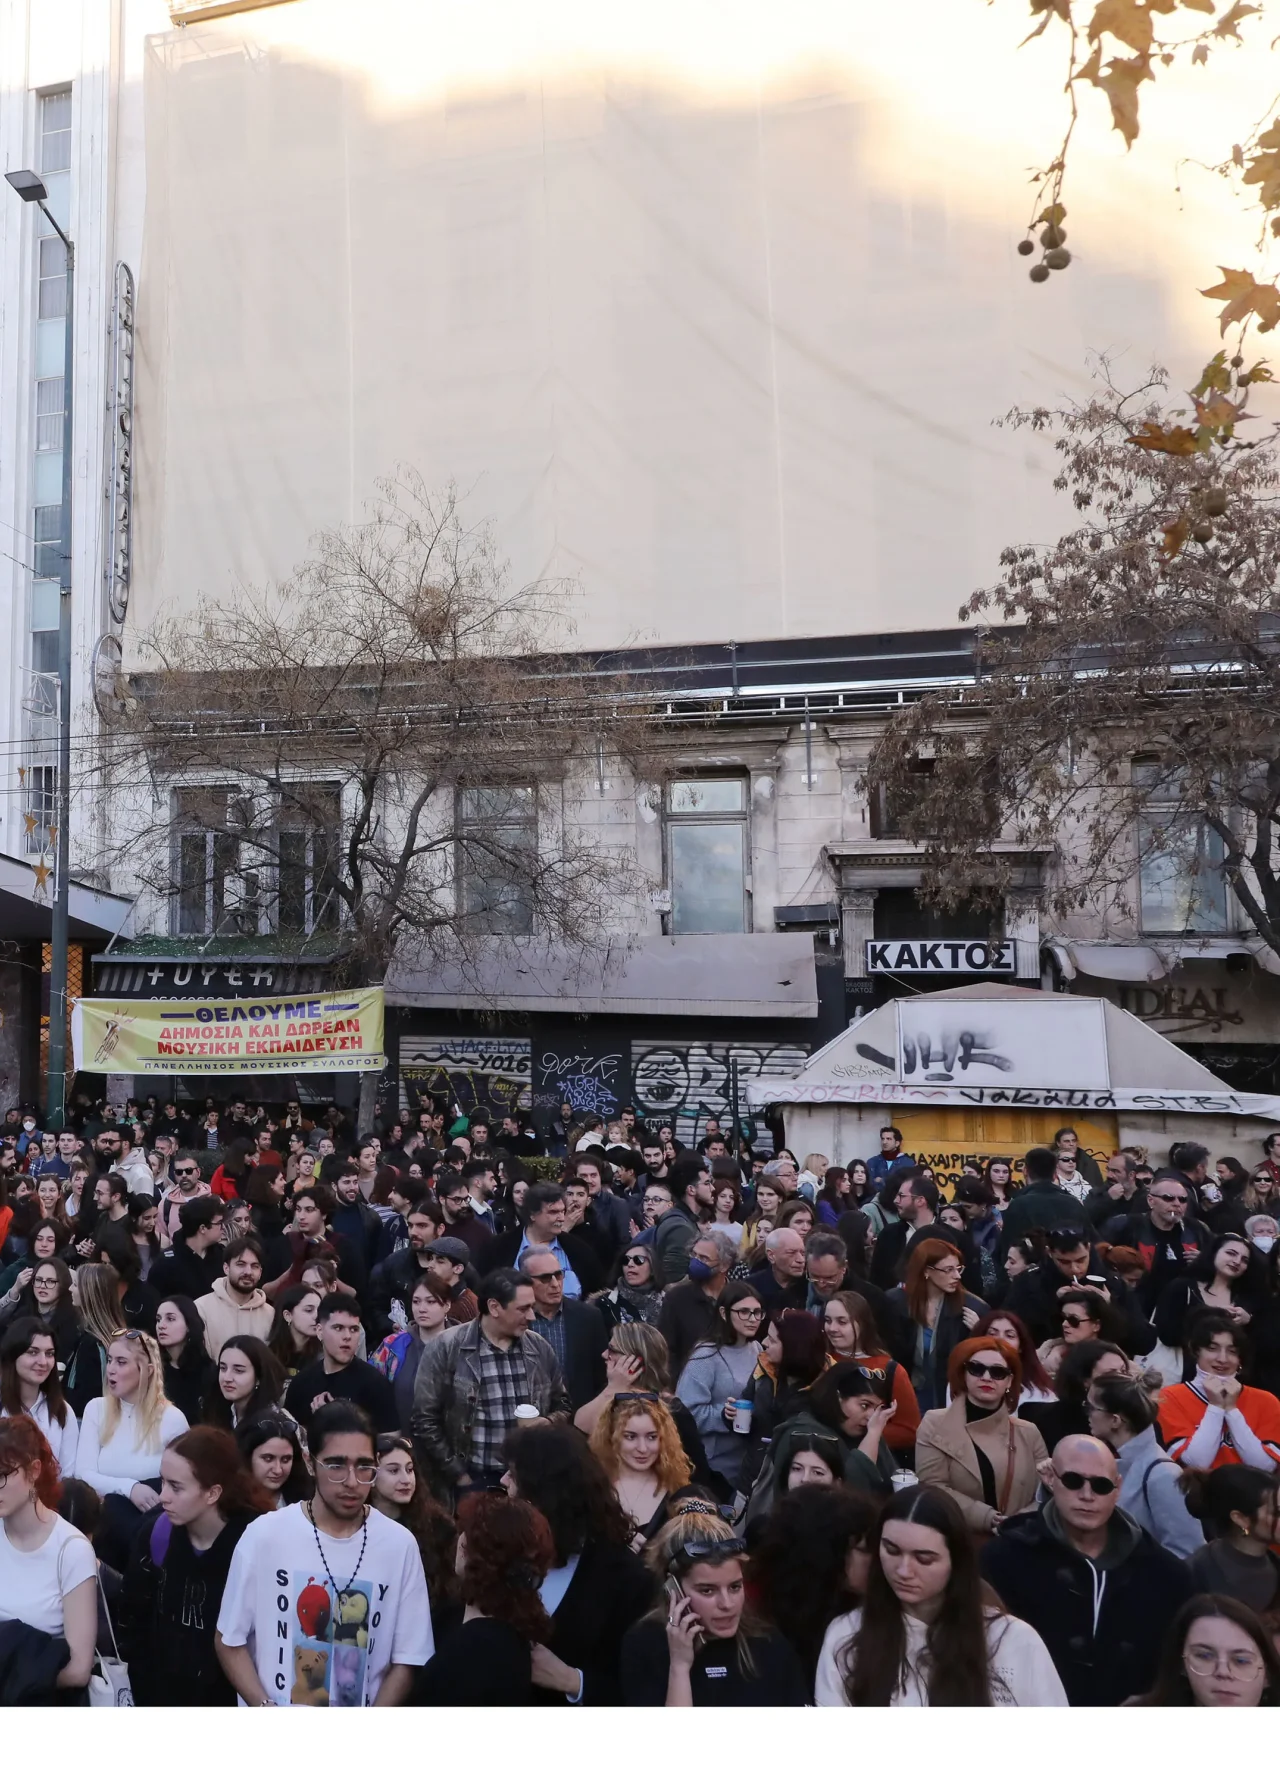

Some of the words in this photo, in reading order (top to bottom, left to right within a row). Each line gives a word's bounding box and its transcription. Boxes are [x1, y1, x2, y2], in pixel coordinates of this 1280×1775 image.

[870, 942, 1012, 970] ΚΑΚΤΟΣ
[195, 1000, 321, 1022] ΘΕΛΟΥΜΕ
[1118, 985, 1244, 1025] IDEAL
[159, 1020, 243, 1040] ΔΗΜΟΣΙΑ
[249, 1023, 280, 1038] ΚΑΙ
[285, 1019, 361, 1037] ΔΩΡΕΑΝ
[157, 1041, 240, 1056] ΜΟΥΣΙΚΗ
[245, 1035, 363, 1054] ΕΚΠΑΙΔΕΥΣΗ
[144, 1062, 235, 1070] ΠΑΝΕΛΛΗΝΙΟΣ
[240, 1060, 307, 1069] ΜΟΥΣΙΚΟΣ
[312, 1058, 379, 1067] ΣΥΛΛΟΓΟΣ
[275, 1568, 290, 1691] SONIC
